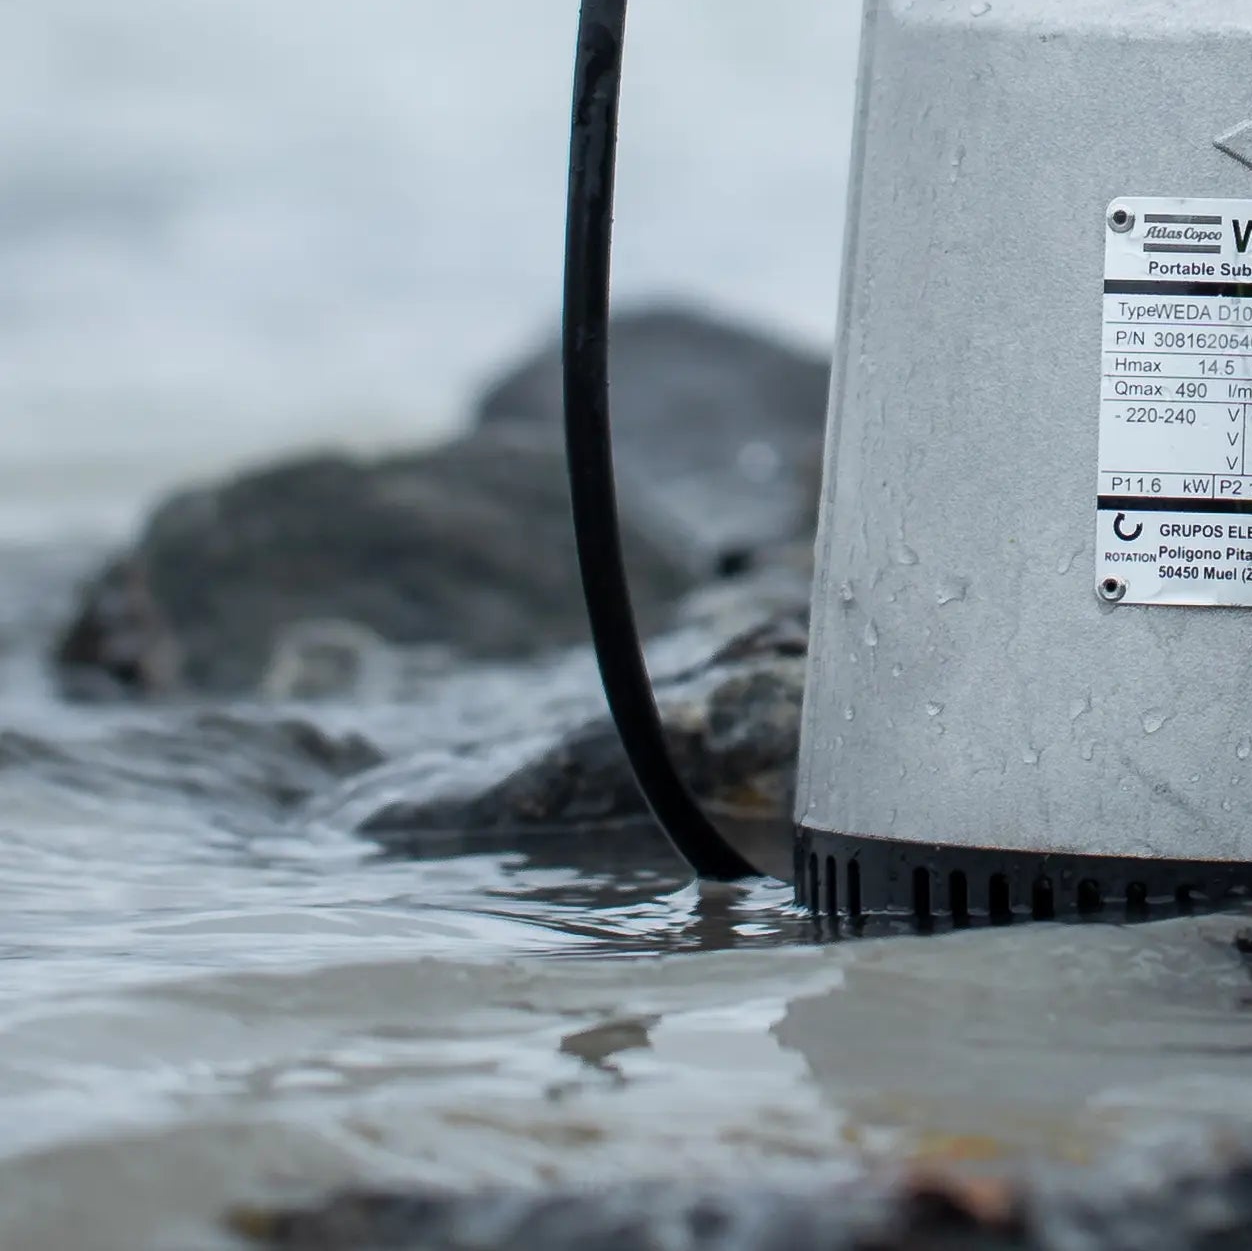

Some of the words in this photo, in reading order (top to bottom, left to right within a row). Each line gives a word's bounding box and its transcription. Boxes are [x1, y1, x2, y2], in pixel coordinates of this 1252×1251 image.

[1149, 261, 1215, 276] Portable
[1116, 331, 1145, 346] P/N
[1115, 357, 1162, 373] Hmax
[1199, 360, 1235, 376] 14.5
[1114, 380, 1163, 397] Qmax
[1175, 383, 1208, 398] 490
[1126, 407, 1197, 424] 220-240
[1228, 407, 1240, 422] V
[1227, 432, 1239, 446] V
[1226, 456, 1239, 470] V
[1183, 479, 1210, 494] kW
[1220, 480, 1242, 495] P2
[1159, 524, 1224, 539] GRUPOS
[1104, 552, 1157, 563] ROTATION
[1158, 565, 1200, 580] 50450
[1203, 566, 1237, 581] Muel
